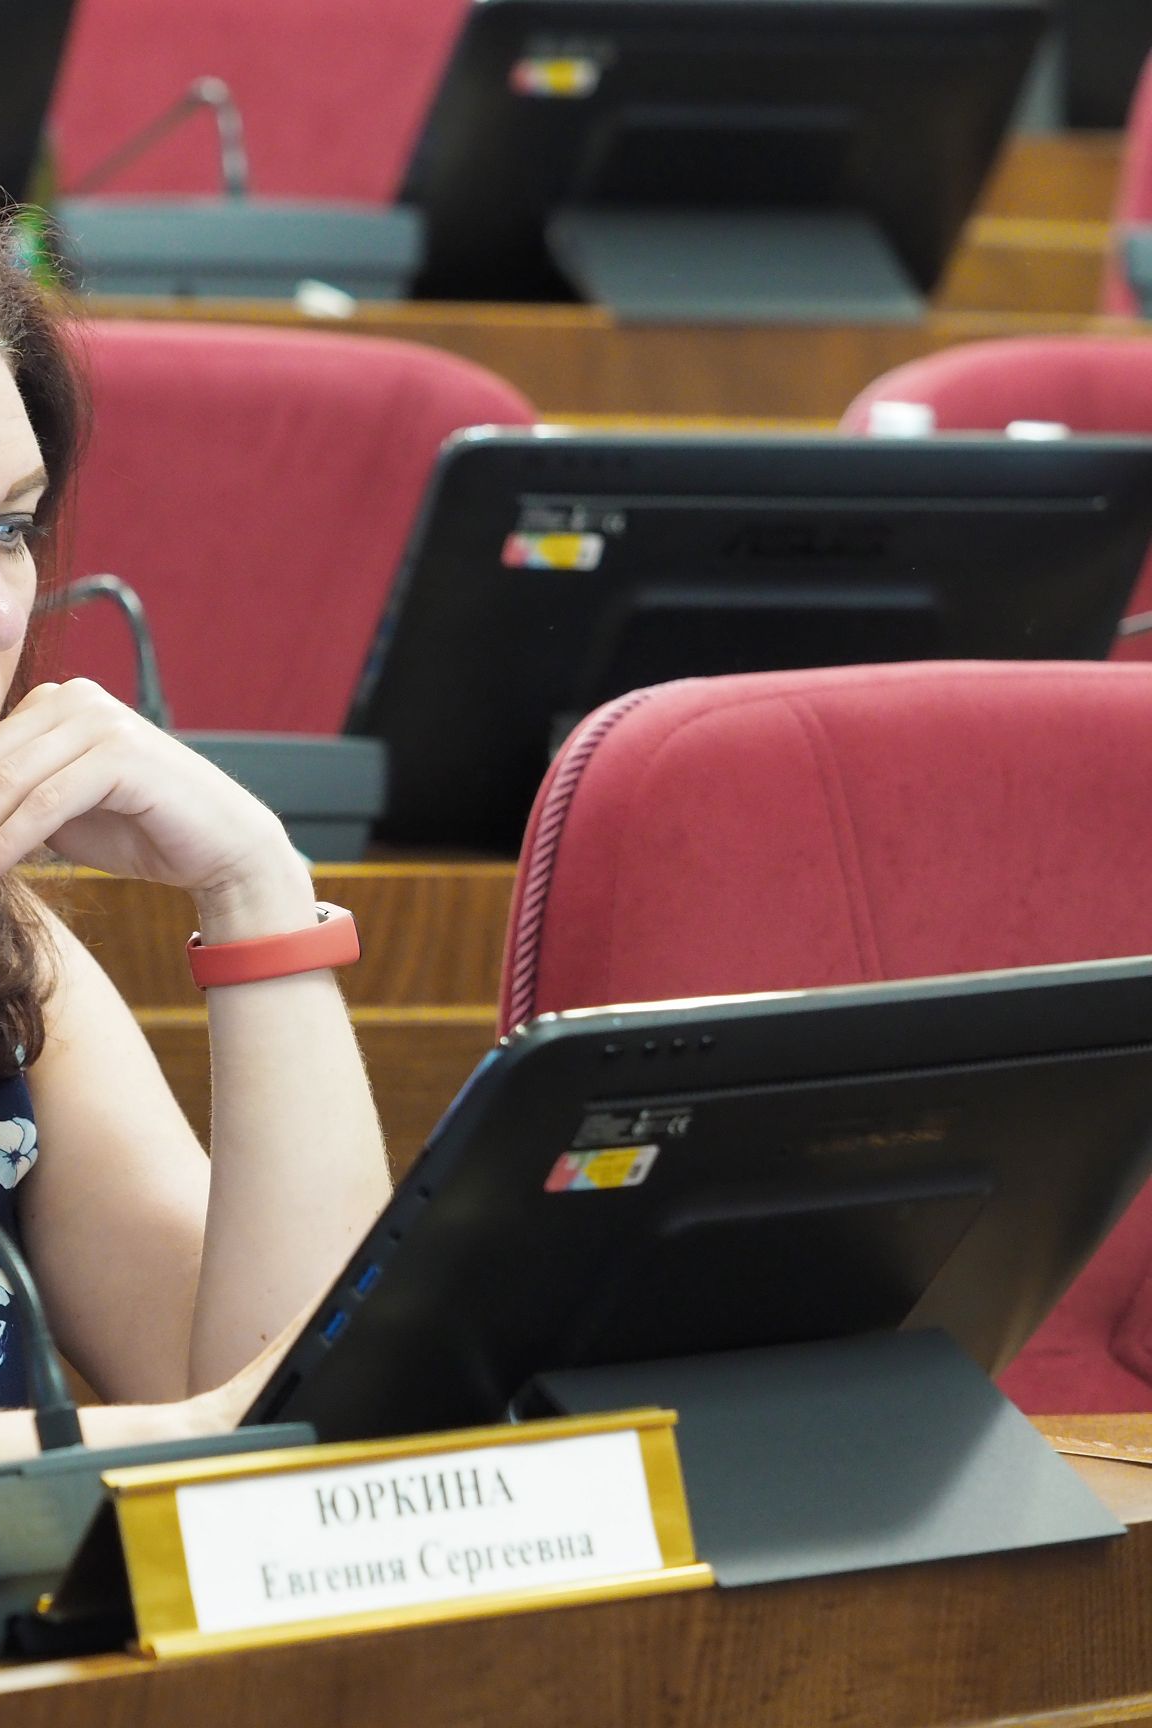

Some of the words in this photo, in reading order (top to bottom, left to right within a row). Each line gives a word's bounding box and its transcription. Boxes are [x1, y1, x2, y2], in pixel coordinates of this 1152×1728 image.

[315, 1466, 515, 1526] ЮРКИНА
[260, 1557, 407, 1600] Евгения
[419, 1532, 595, 1583] Сергеевна
